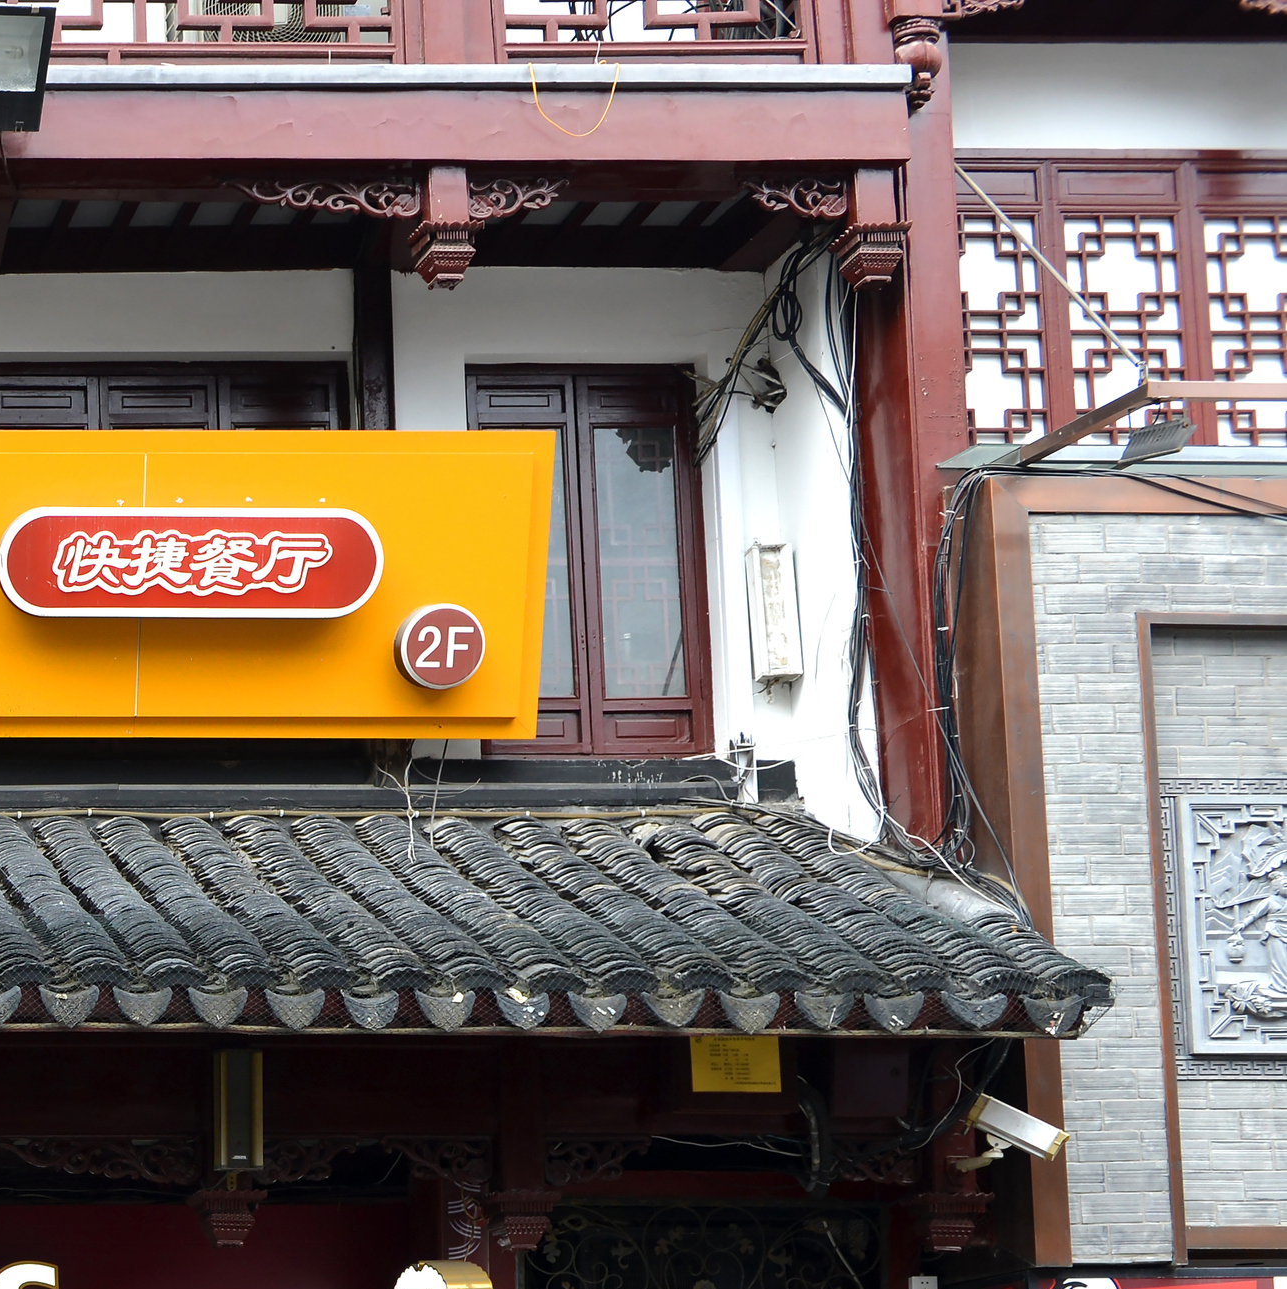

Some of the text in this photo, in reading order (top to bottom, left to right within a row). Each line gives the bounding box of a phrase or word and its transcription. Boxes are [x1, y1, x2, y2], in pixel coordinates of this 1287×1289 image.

[63, 533, 330, 589] 快捷餐厅
[414, 625, 475, 669] 2F
